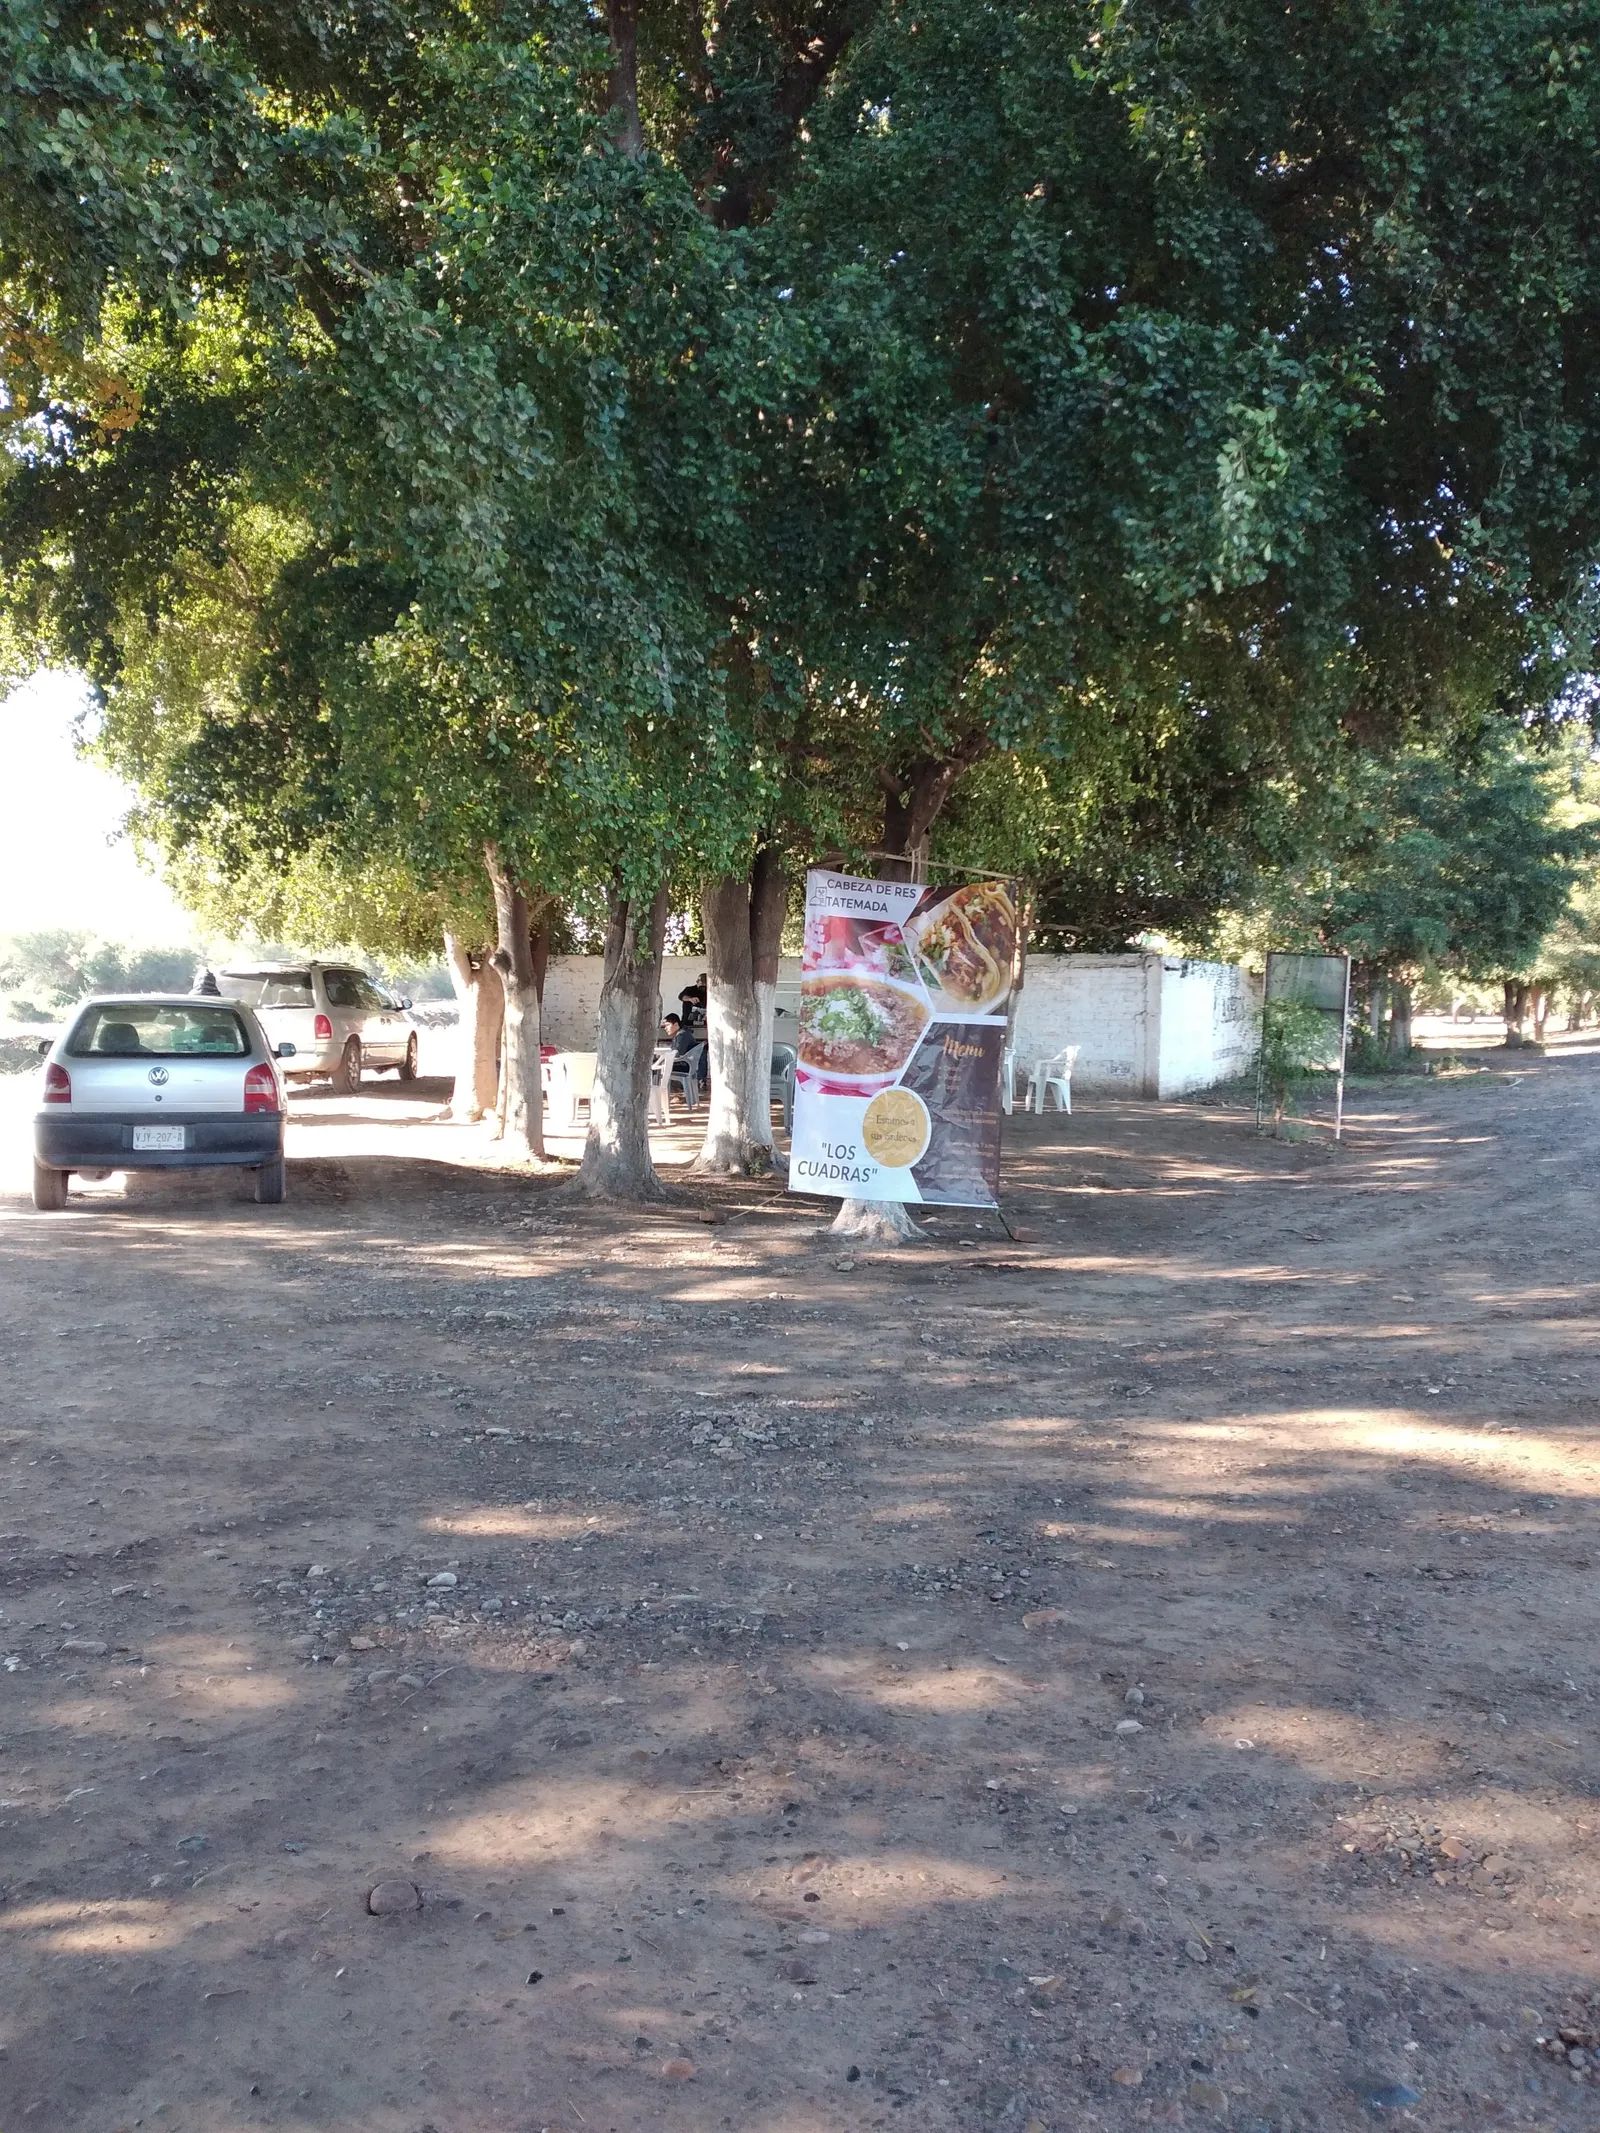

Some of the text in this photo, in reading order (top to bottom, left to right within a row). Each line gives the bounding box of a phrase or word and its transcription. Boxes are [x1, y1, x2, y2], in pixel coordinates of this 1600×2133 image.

[827, 879, 916, 899] CABEZA DE RES
[826, 896, 888, 913] TATEMADA
[135, 1132, 183, 1143] VJY-207-A
[870, 1132, 883, 1141] sus
[821, 1142, 857, 1161] "LOS
[797, 1160, 879, 1183] CUADRAS"
